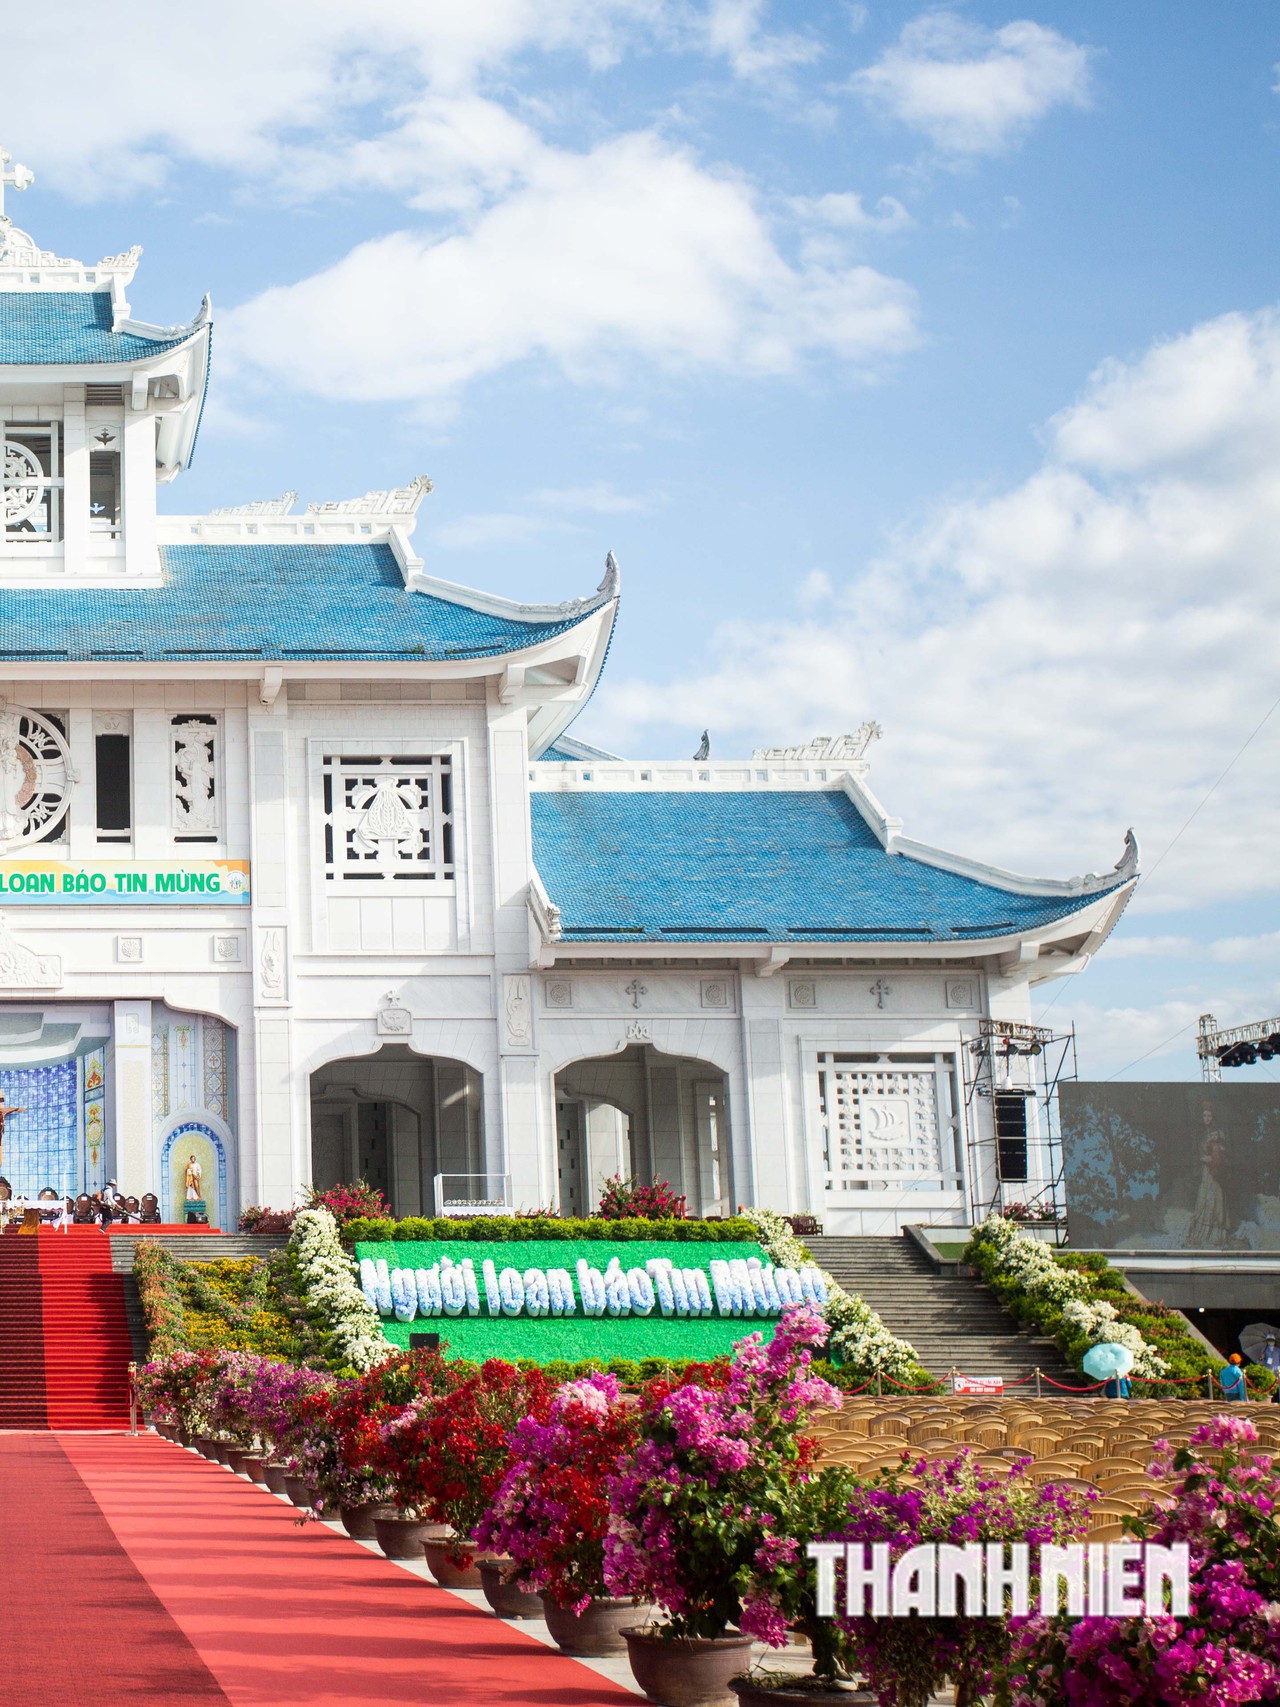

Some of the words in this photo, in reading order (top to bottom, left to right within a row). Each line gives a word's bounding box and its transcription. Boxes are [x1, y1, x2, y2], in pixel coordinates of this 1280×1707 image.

[62, 869, 106, 893] BÁO
[114, 873, 147, 893] TIN
[155, 869, 221, 893] MỪNG
